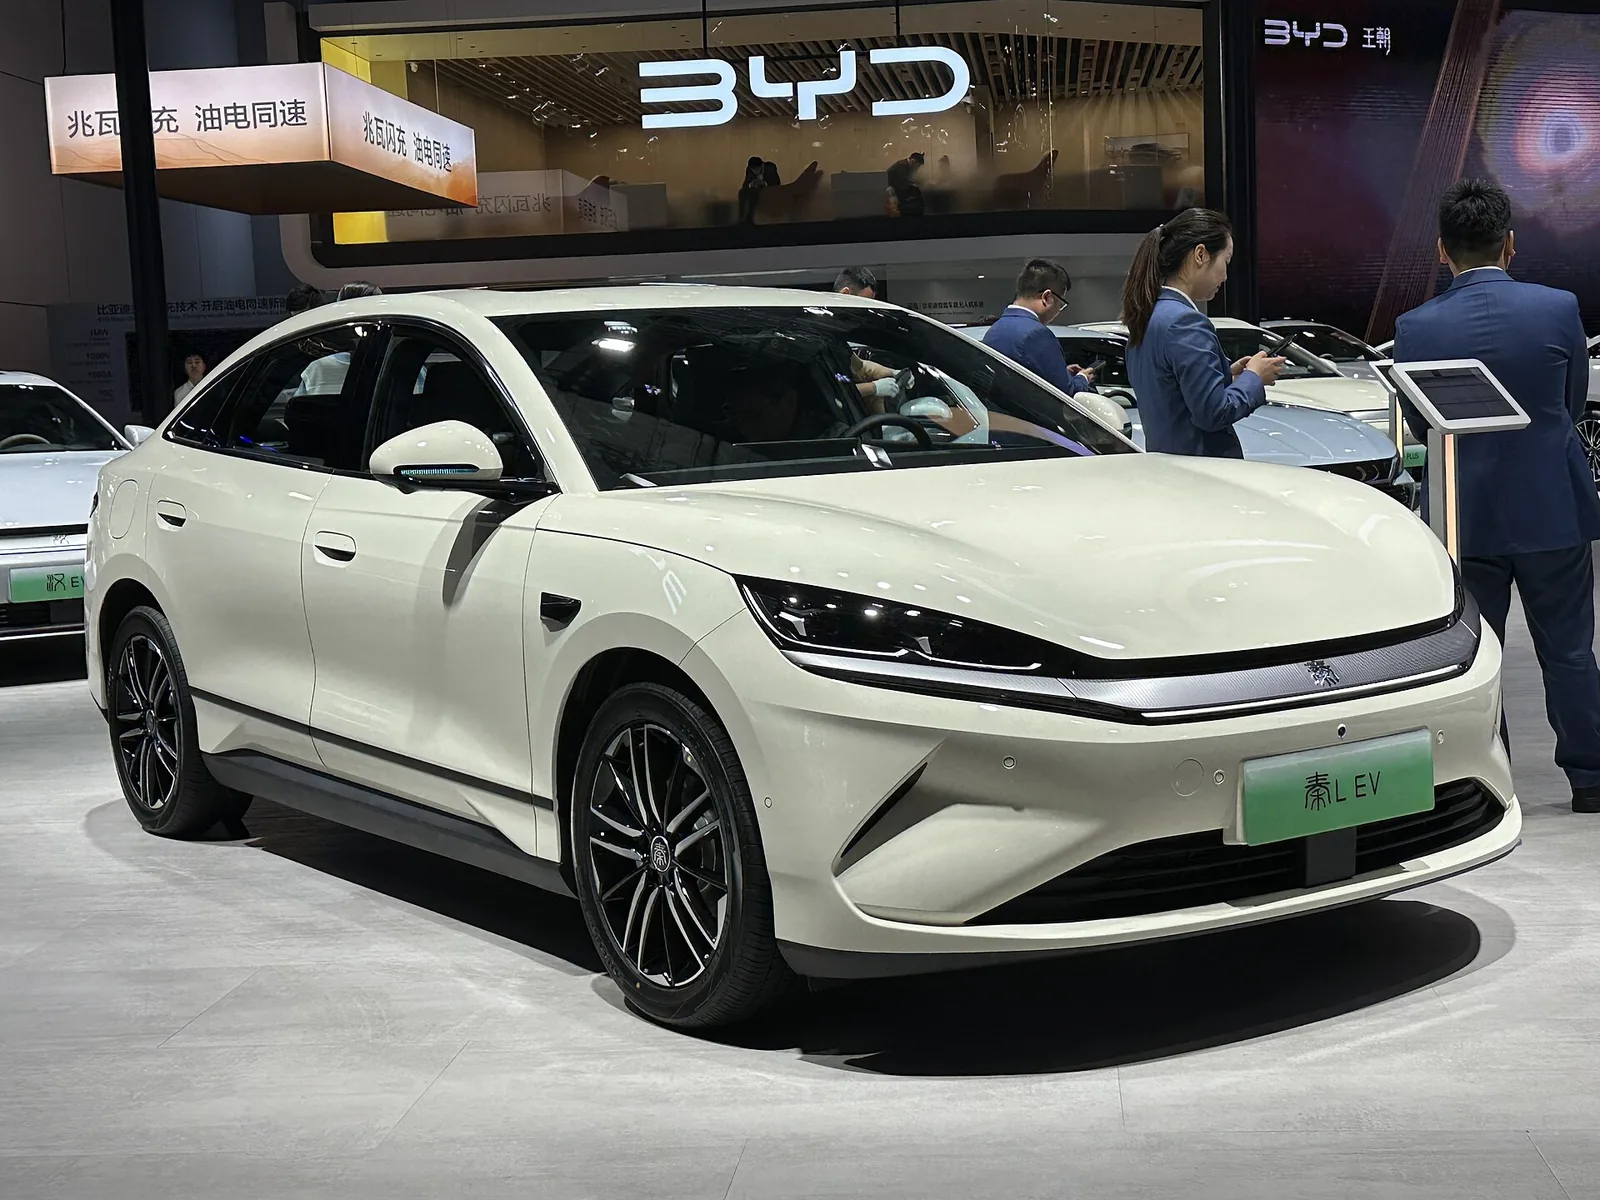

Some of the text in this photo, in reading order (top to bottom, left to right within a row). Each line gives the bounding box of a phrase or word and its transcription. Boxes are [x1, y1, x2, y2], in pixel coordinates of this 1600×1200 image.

[1264, 19, 1391, 55] BYD 王朝
[638, 46, 971, 129] BYD
[67, 98, 308, 139] 兆瓦充 油电同速
[362, 110, 452, 172] 兆瓦闪充 油电同速
[1406, 452, 1420, 460] PLUS
[1354, 770, 1381, 798] EV
